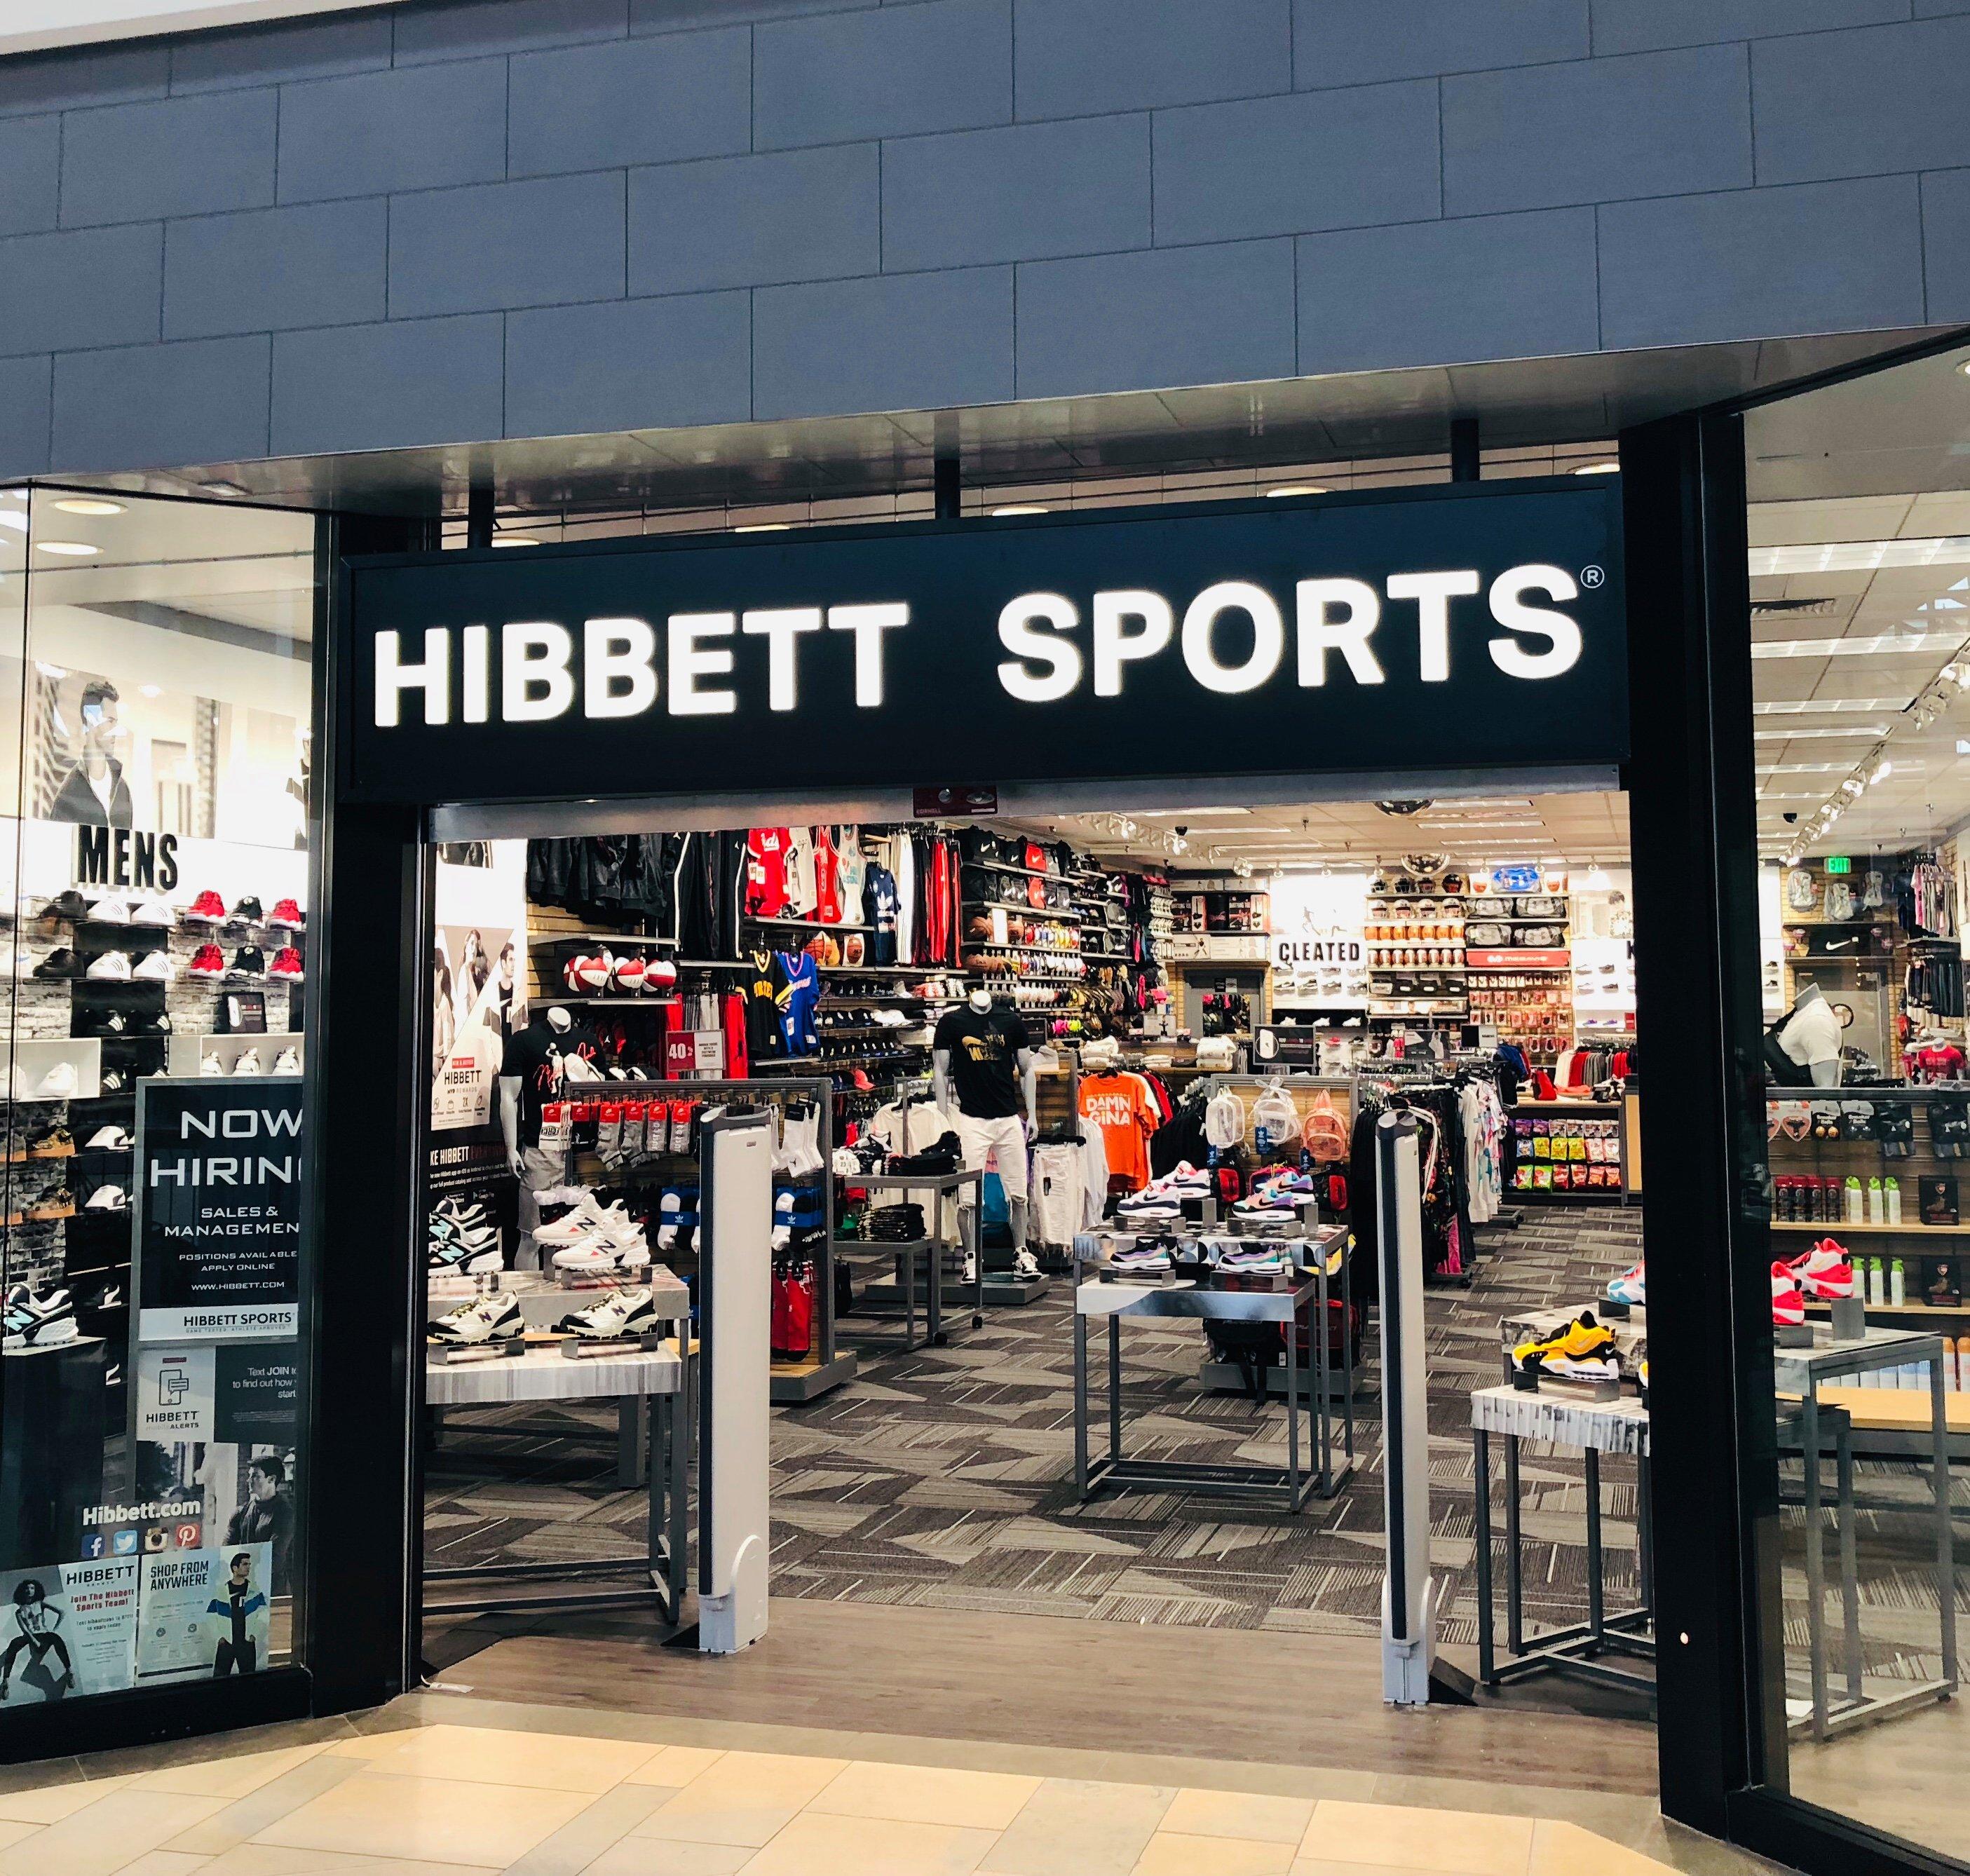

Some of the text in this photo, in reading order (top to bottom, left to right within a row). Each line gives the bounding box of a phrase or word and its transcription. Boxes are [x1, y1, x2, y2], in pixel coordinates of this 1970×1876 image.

[374, 603, 910, 728] HIBBETT
[996, 564, 1584, 703] SPORTS
[76, 824, 179, 891] MENS
[1828, 858, 1849, 874] EXIT
[1279, 942, 1359, 961] CLEATED
[669, 1042, 686, 1059] 40
[444, 1070, 482, 1085] HIBBETT
[1086, 1096, 1131, 1112] DAMN
[181, 1109, 303, 1139] NOW
[1089, 1110, 1130, 1125] GINA
[430, 1150, 438, 1167] KE
[440, 1146, 469, 1164] HIBBETT
[150, 1156, 301, 1187] HIRIN
[201, 1206, 278, 1218] SALES &
[164, 1223, 299, 1237] MANAGEMEN
[179, 1251, 297, 1260] POSITIONS AVAILABLE
[191, 1282, 285, 1291] WWW.HIBBETT.COM
[184, 1312, 292, 1326] HIBBETT SPORTS
[247, 1367, 265, 1376] Text
[266, 1366, 290, 1376] JOIN
[232, 1380, 241, 1389] to
[243, 1379, 258, 1388] find
[259, 1379, 273, 1387] out
[275, 1378, 292, 1387] how
[146, 1411, 199, 1423] HIBBETT
[83, 1500, 201, 1526] Hibbett.com
[67, 1565, 135, 1585] HIBBETT
[151, 1560, 209, 1579] SHOP FROM
[150, 1573, 208, 1591] ANYWHERE
[71, 1589, 135, 1603] Join The Hibbett
[76, 1598, 128, 1612] Sports Team!
